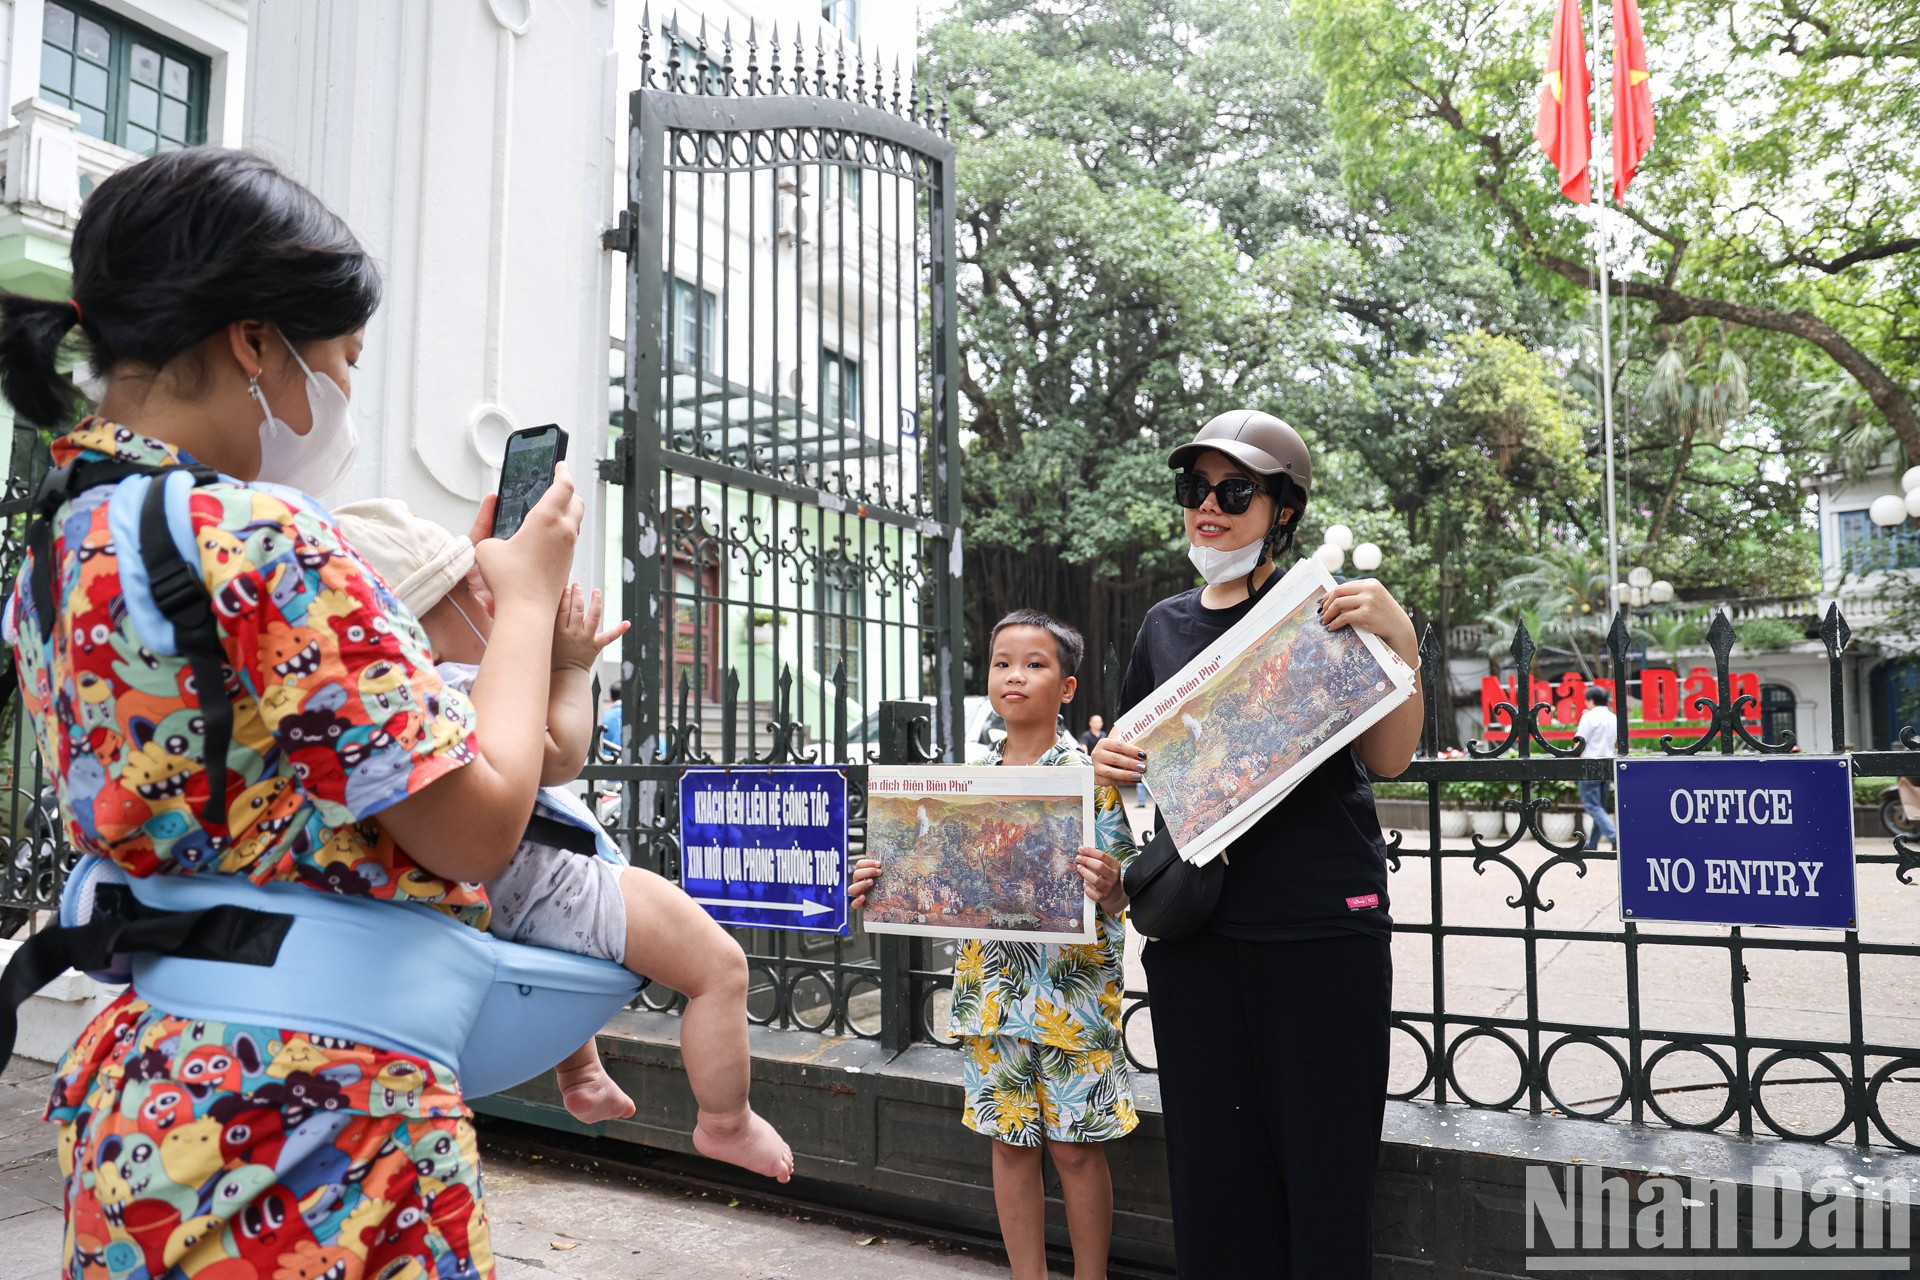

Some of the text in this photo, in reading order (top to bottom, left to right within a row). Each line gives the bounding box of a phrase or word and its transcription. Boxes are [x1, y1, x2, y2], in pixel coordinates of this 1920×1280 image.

[1133, 713, 1155, 734] dịch
[1154, 696, 1178, 716] Điện
[1176, 677, 1201, 699] Biên
[1640, 666, 1762, 722] Dân
[694, 779, 830, 831] KHÁCH ĐẾN LIÊN HỆ CÔNG TÁC
[879, 779, 900, 793] dịch
[903, 779, 924, 793] Điện
[926, 780, 947, 792] Biên
[1669, 788, 1793, 825] OFFICE
[687, 838, 840, 894] XIN MỜI QUA PHÒNG THƯỜNG TRỰC
[1646, 857, 1824, 898] NO ENTRY
